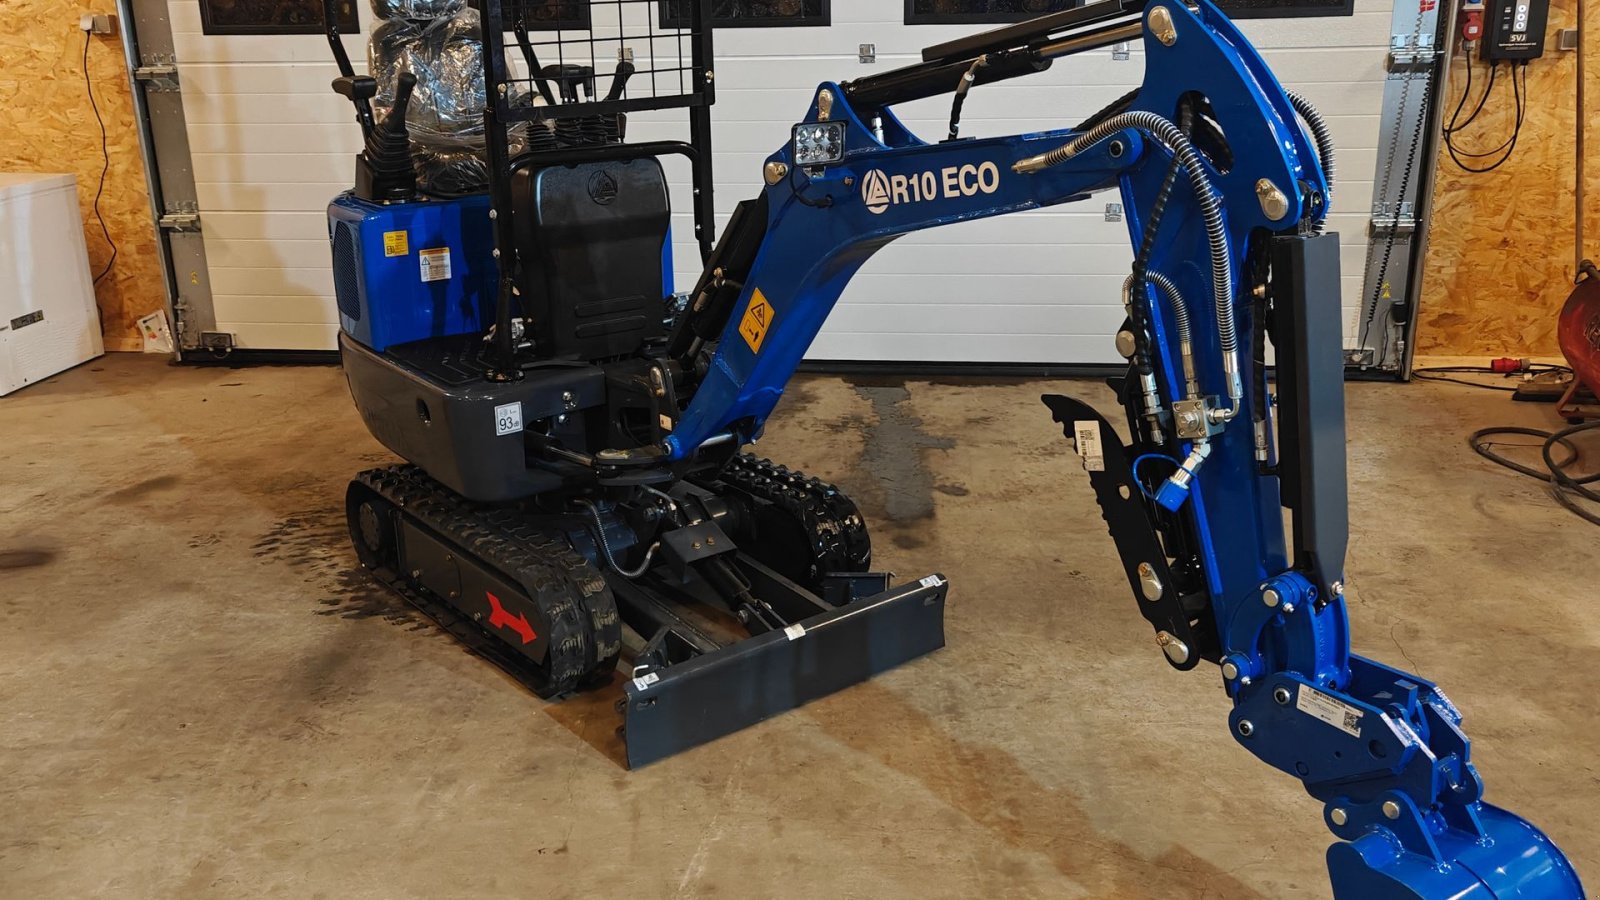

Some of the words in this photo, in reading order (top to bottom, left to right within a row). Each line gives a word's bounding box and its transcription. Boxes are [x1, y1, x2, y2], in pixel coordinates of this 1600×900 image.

[1510, 34, 1526, 42] SVJ
[891, 171, 937, 204] R10
[942, 161, 999, 198] ECO
[500, 417, 513, 430] 93
